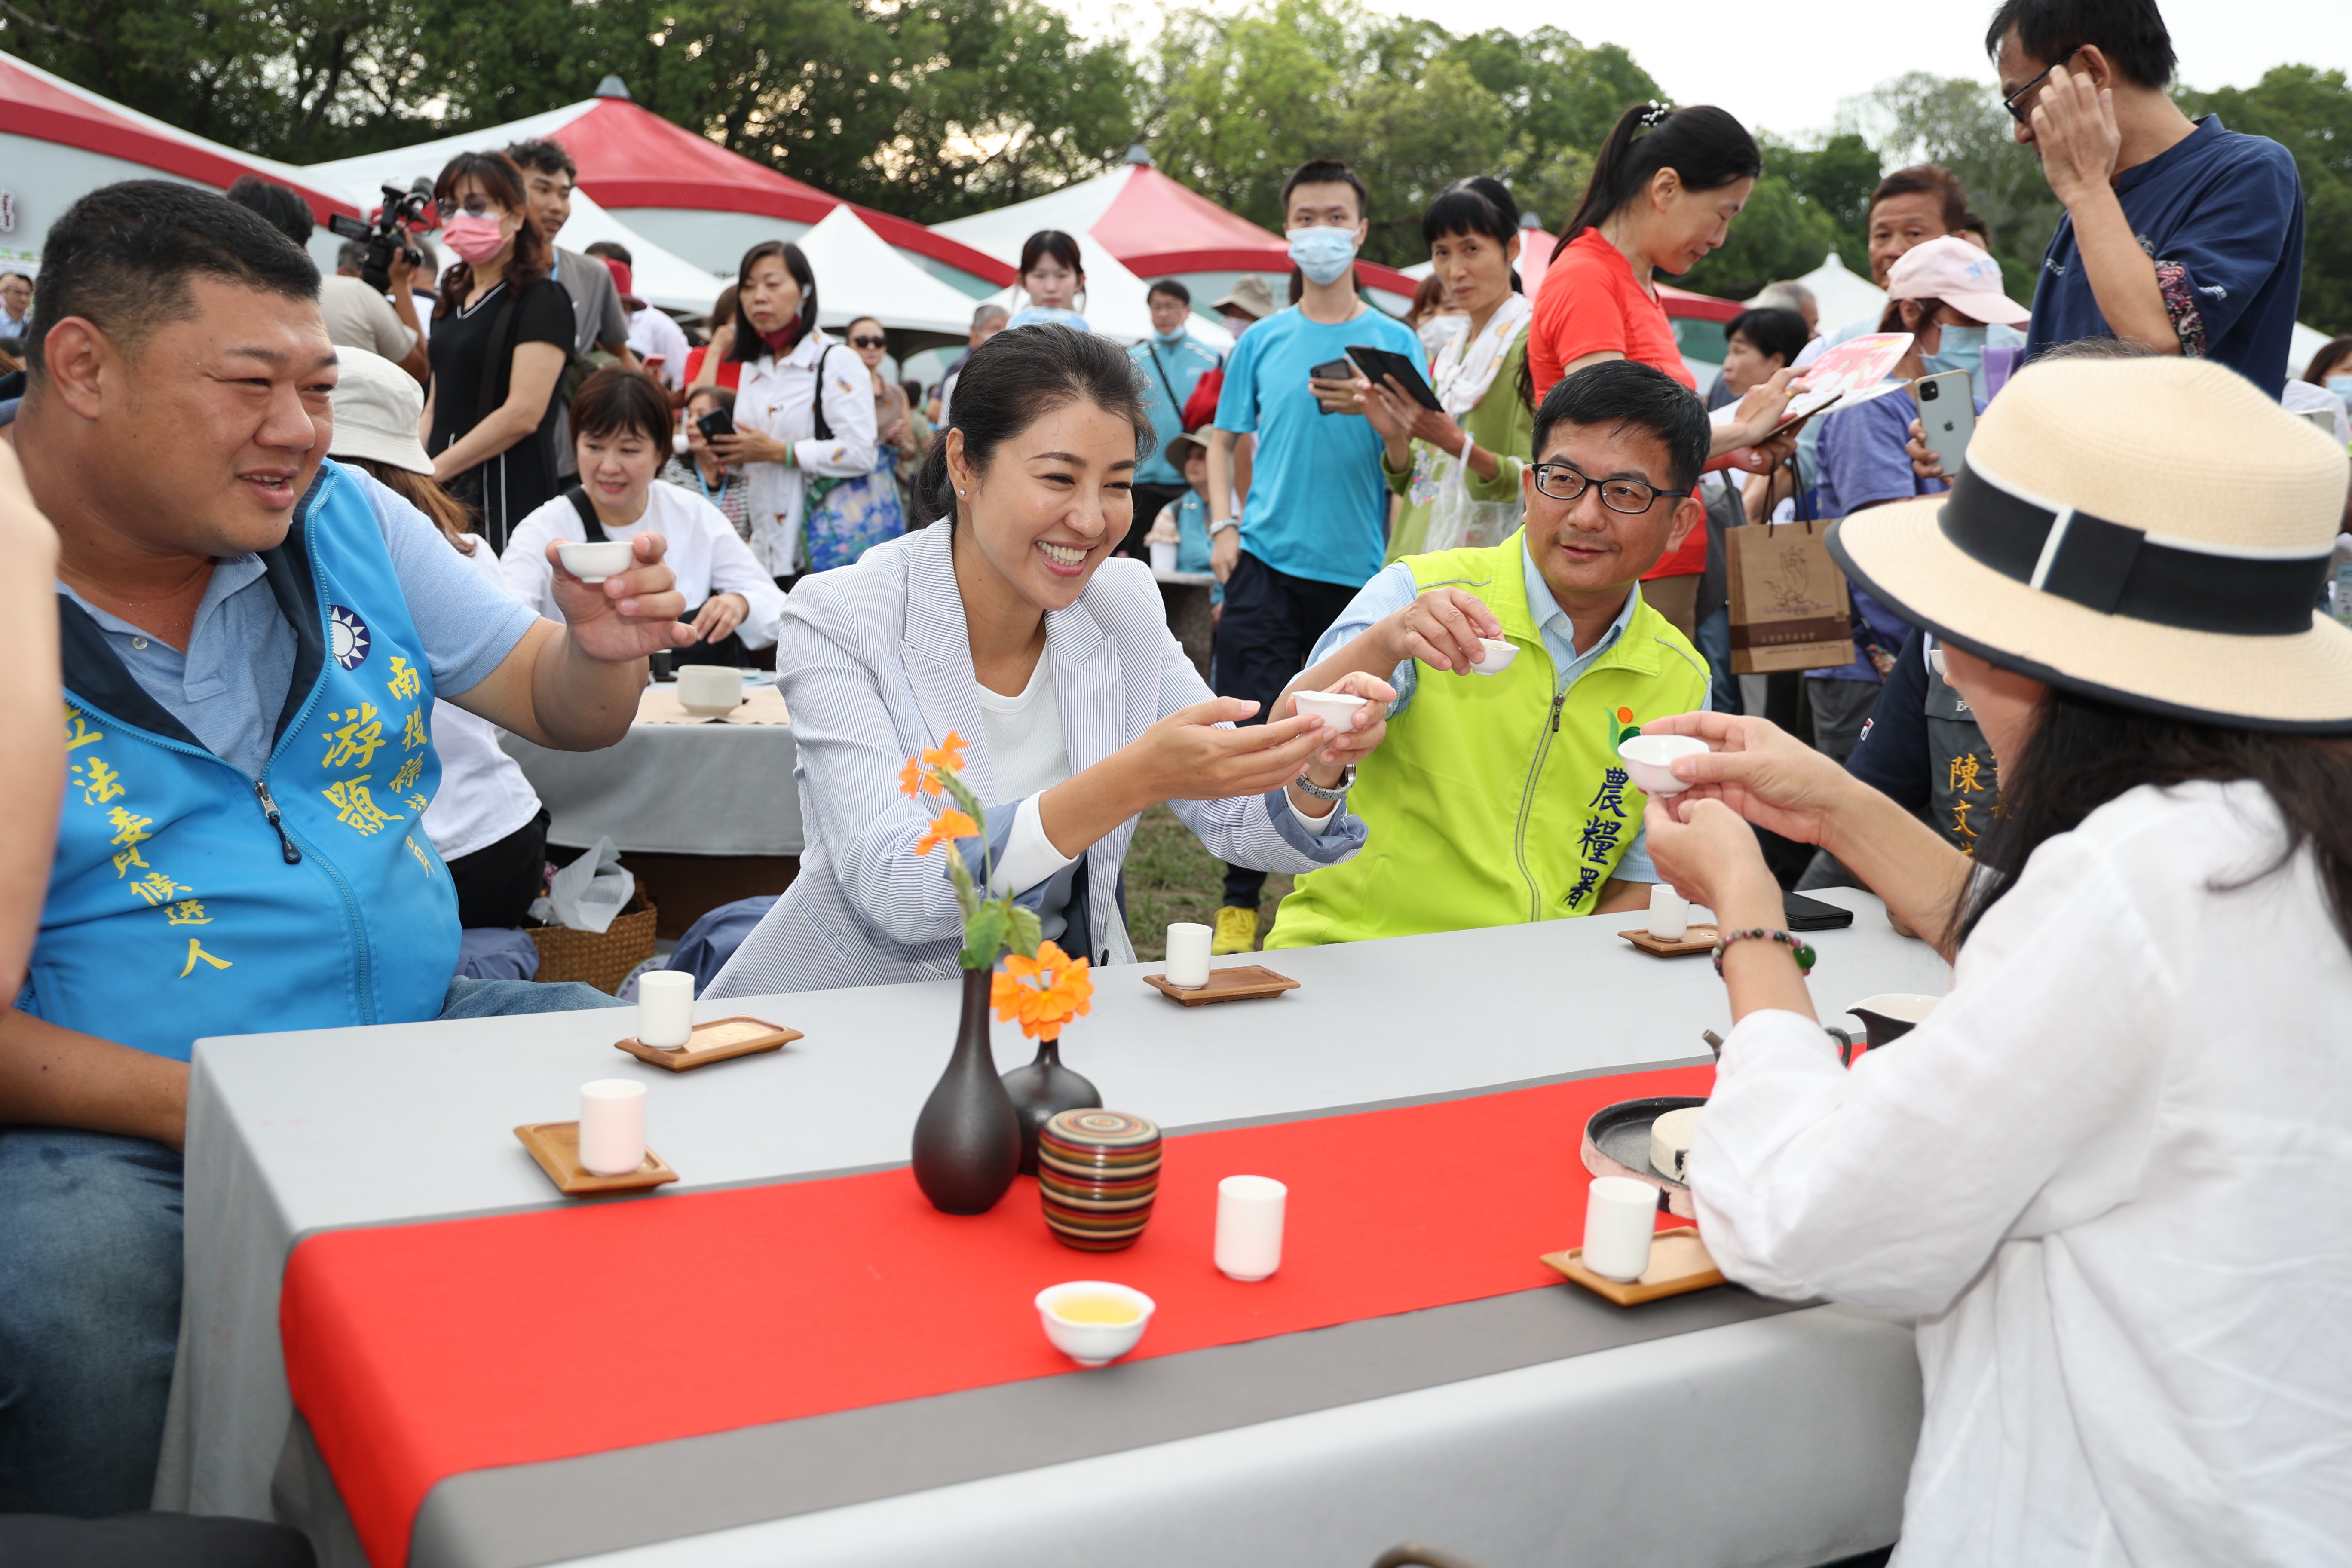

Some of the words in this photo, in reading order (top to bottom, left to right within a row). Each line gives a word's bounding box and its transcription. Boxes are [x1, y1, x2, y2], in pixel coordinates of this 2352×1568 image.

[322, 702, 404, 836] 游顥
[1563, 766, 1629, 909] 農糧署
